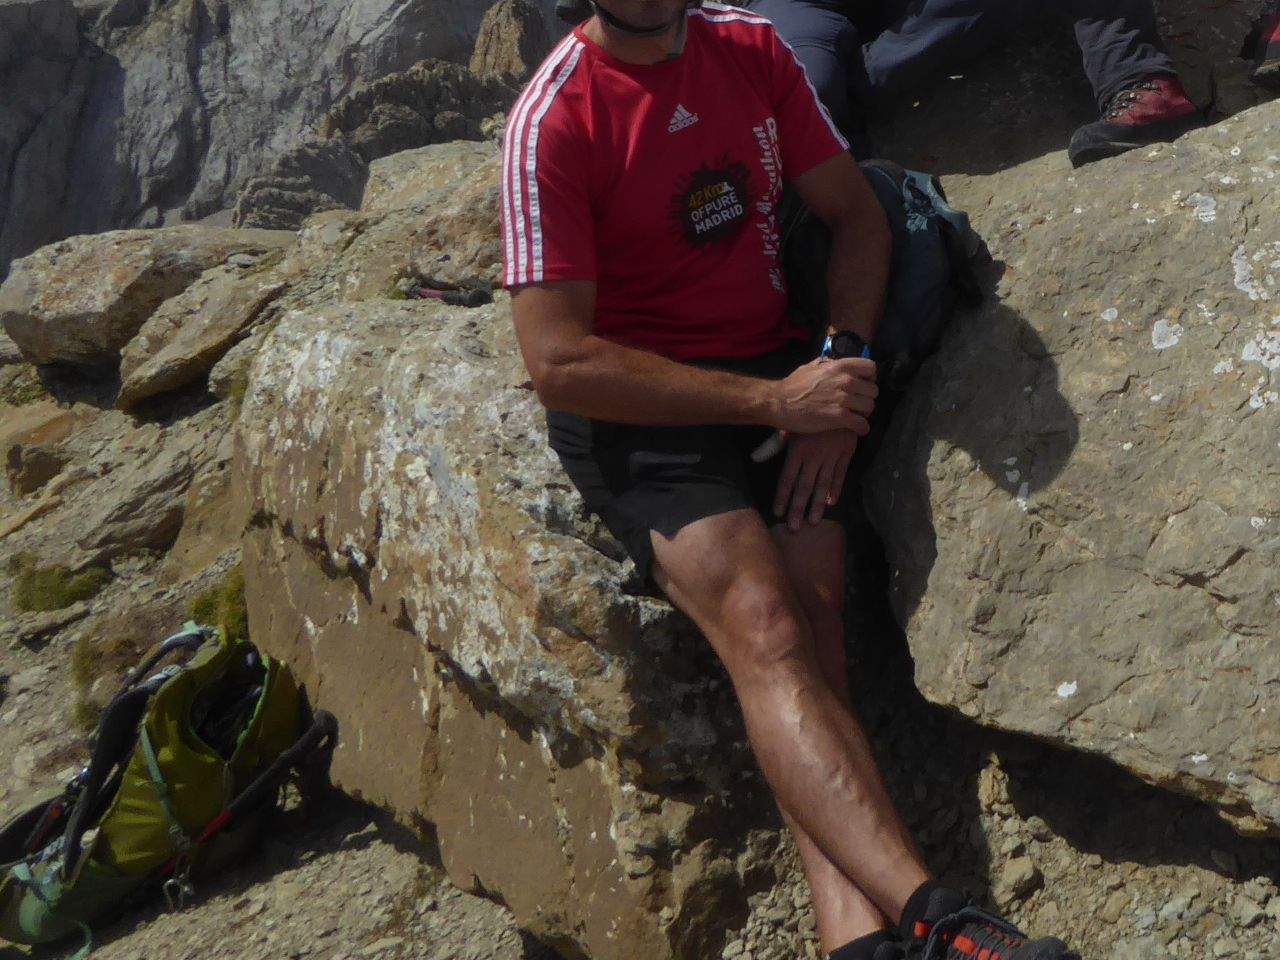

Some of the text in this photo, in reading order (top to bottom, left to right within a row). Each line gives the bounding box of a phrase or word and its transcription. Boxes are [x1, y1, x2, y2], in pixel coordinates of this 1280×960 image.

[666, 114, 699, 133] adidas
[705, 192, 738, 215] PURE
[695, 203, 743, 235] MADRID
